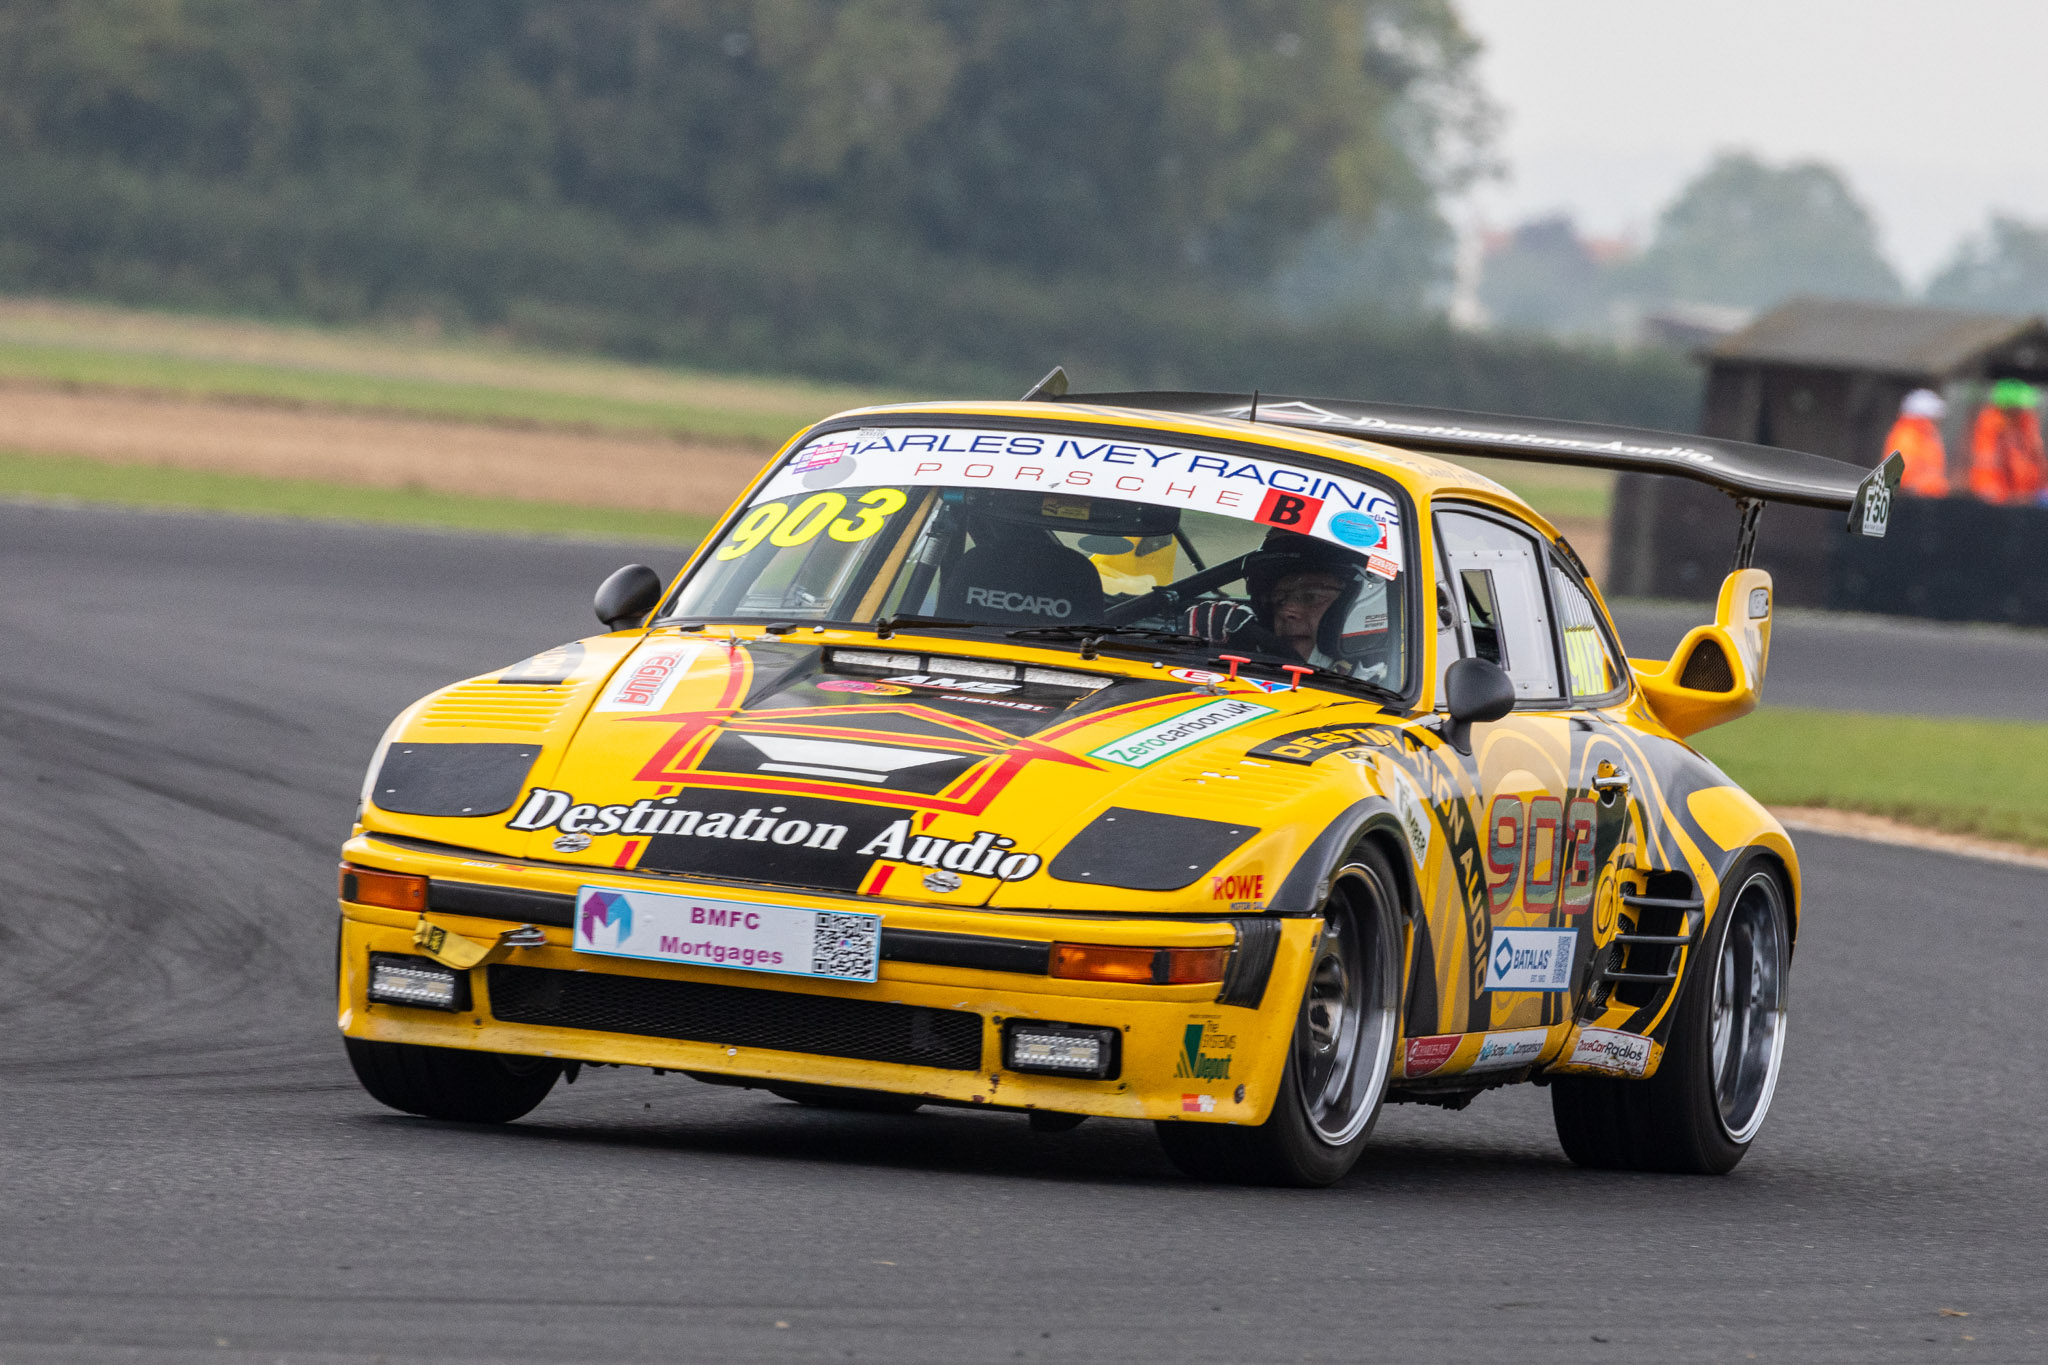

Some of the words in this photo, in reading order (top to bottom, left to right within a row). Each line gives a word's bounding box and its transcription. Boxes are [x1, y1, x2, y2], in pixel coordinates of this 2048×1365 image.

[1599, 441, 1713, 462] Audio
[914, 462, 1244, 507] PORSCHE
[1055, 440, 1181, 468] IVEY
[1187, 455, 1399, 526] RACING
[716, 488, 907, 561] 903
[1268, 494, 1306, 526] B
[966, 586, 1071, 619] RECARO
[614, 650, 684, 706] TEGIWA
[879, 674, 1023, 694] AMS
[507, 788, 849, 850] Destination
[856, 819, 1041, 881] Audio
[1487, 795, 1598, 914] 903
[1212, 875, 1264, 900] ROWE
[690, 906, 761, 930] BMFC
[1460, 848, 1488, 1000] AUDIO
[660, 935, 784, 966] Mortgages
